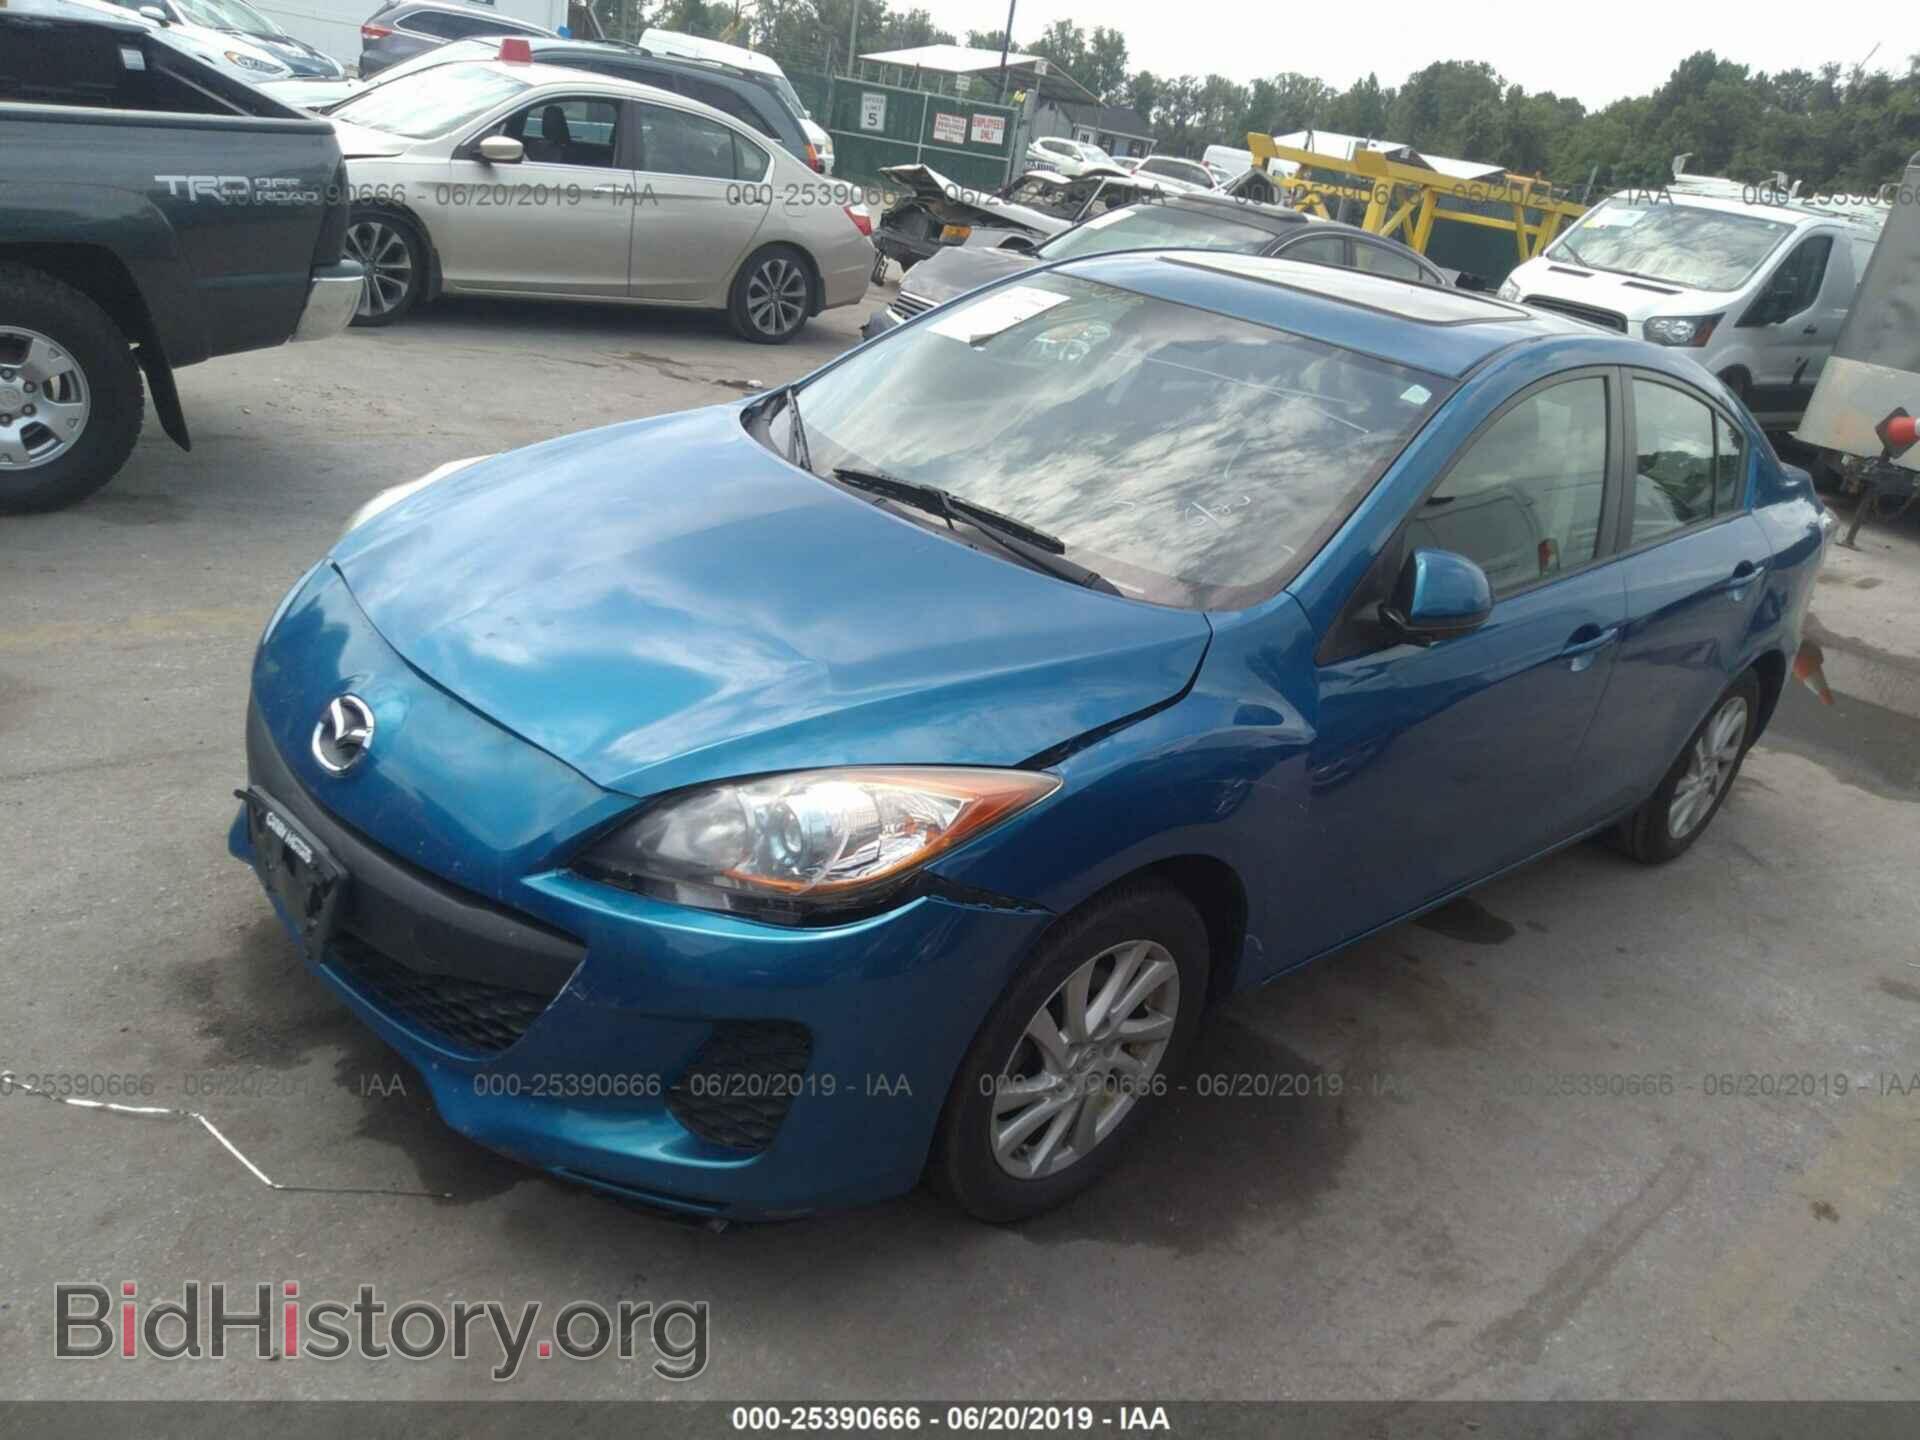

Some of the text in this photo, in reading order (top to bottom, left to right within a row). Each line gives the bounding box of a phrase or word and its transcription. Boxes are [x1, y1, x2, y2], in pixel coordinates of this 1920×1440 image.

[867, 112, 878, 127] 5
[154, 175, 250, 202] TRD
[254, 177, 300, 189] OFF
[255, 190, 318, 201] ROAD
